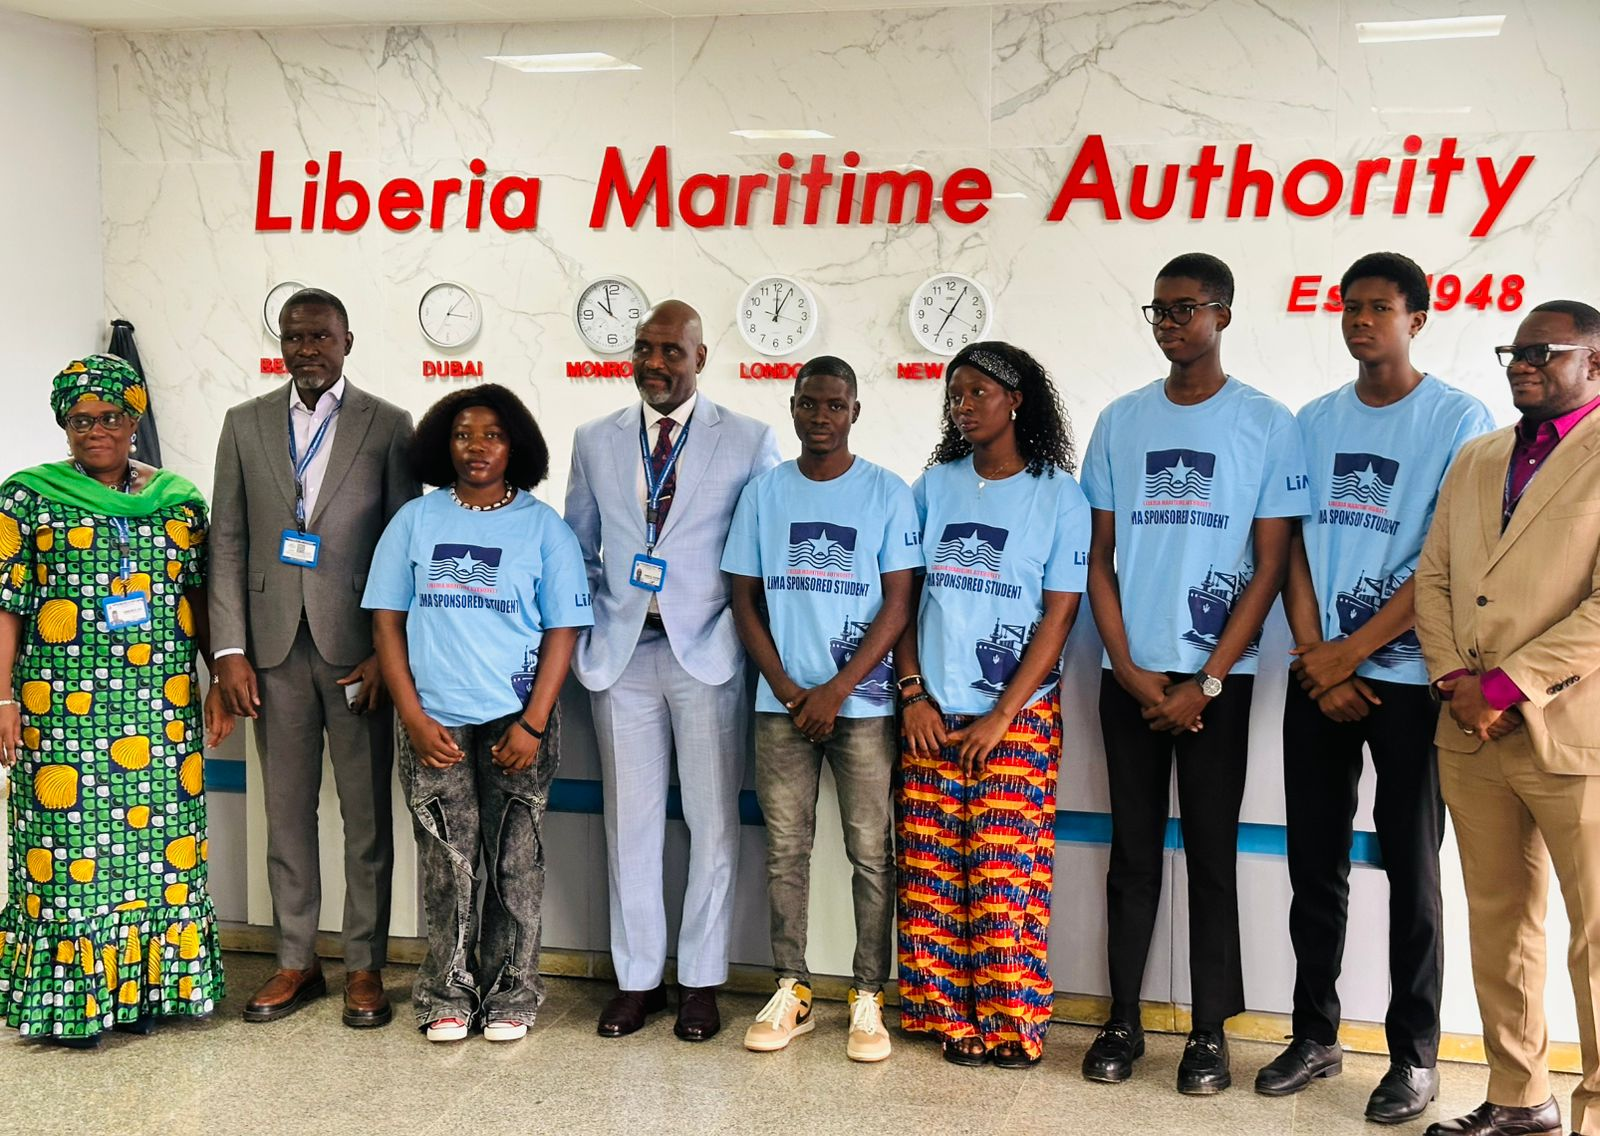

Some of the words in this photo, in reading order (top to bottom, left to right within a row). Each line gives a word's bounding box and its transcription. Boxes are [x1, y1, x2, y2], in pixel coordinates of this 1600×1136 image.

[256, 150, 540, 231] Liberia
[589, 145, 993, 229] Maritime
[1046, 134, 1536, 237] Authority
[933, 286, 942, 295] 11
[946, 281, 956, 291] 12
[760, 287, 769, 296] 11
[1287, 275, 1344, 312] Es
[1425, 273, 1526, 312] 948
[751, 297, 761, 307] 10
[798, 299, 805, 308] 2
[923, 296, 934, 306] 10
[972, 296, 979, 306] 2
[583, 309, 594, 320] 9
[628, 308, 640, 319] 3
[746, 309, 752, 319] 9
[801, 311, 808, 321] 3
[918, 309, 925, 319] 9
[976, 309, 983, 319] 3
[750, 324, 756, 333] 8
[796, 325, 803, 334] 4
[922, 324, 930, 333] 8
[971, 324, 977, 333] 4
[607, 334, 618, 345] 6
[760, 333, 767, 343] 7
[773, 338, 779, 348] 6
[786, 335, 793, 344] 5
[946, 338, 953, 347] 6
[961, 334, 968, 344] 5
[260, 358, 288, 375] BE
[422, 360, 483, 377] DUBAI
[566, 360, 634, 378] MONRO
[740, 362, 803, 380] LONDO
[897, 362, 944, 380] NEW
[1190, 510, 1230, 530] STUDENT
[1329, 509, 1363, 527] SPONSO
[767, 575, 786, 590] LiMA
[786, 575, 833, 593] SPONSORED
[833, 579, 870, 597] STUDENT
[984, 579, 1023, 600] STUDENT
[433, 593, 483, 609] SPONSORED
